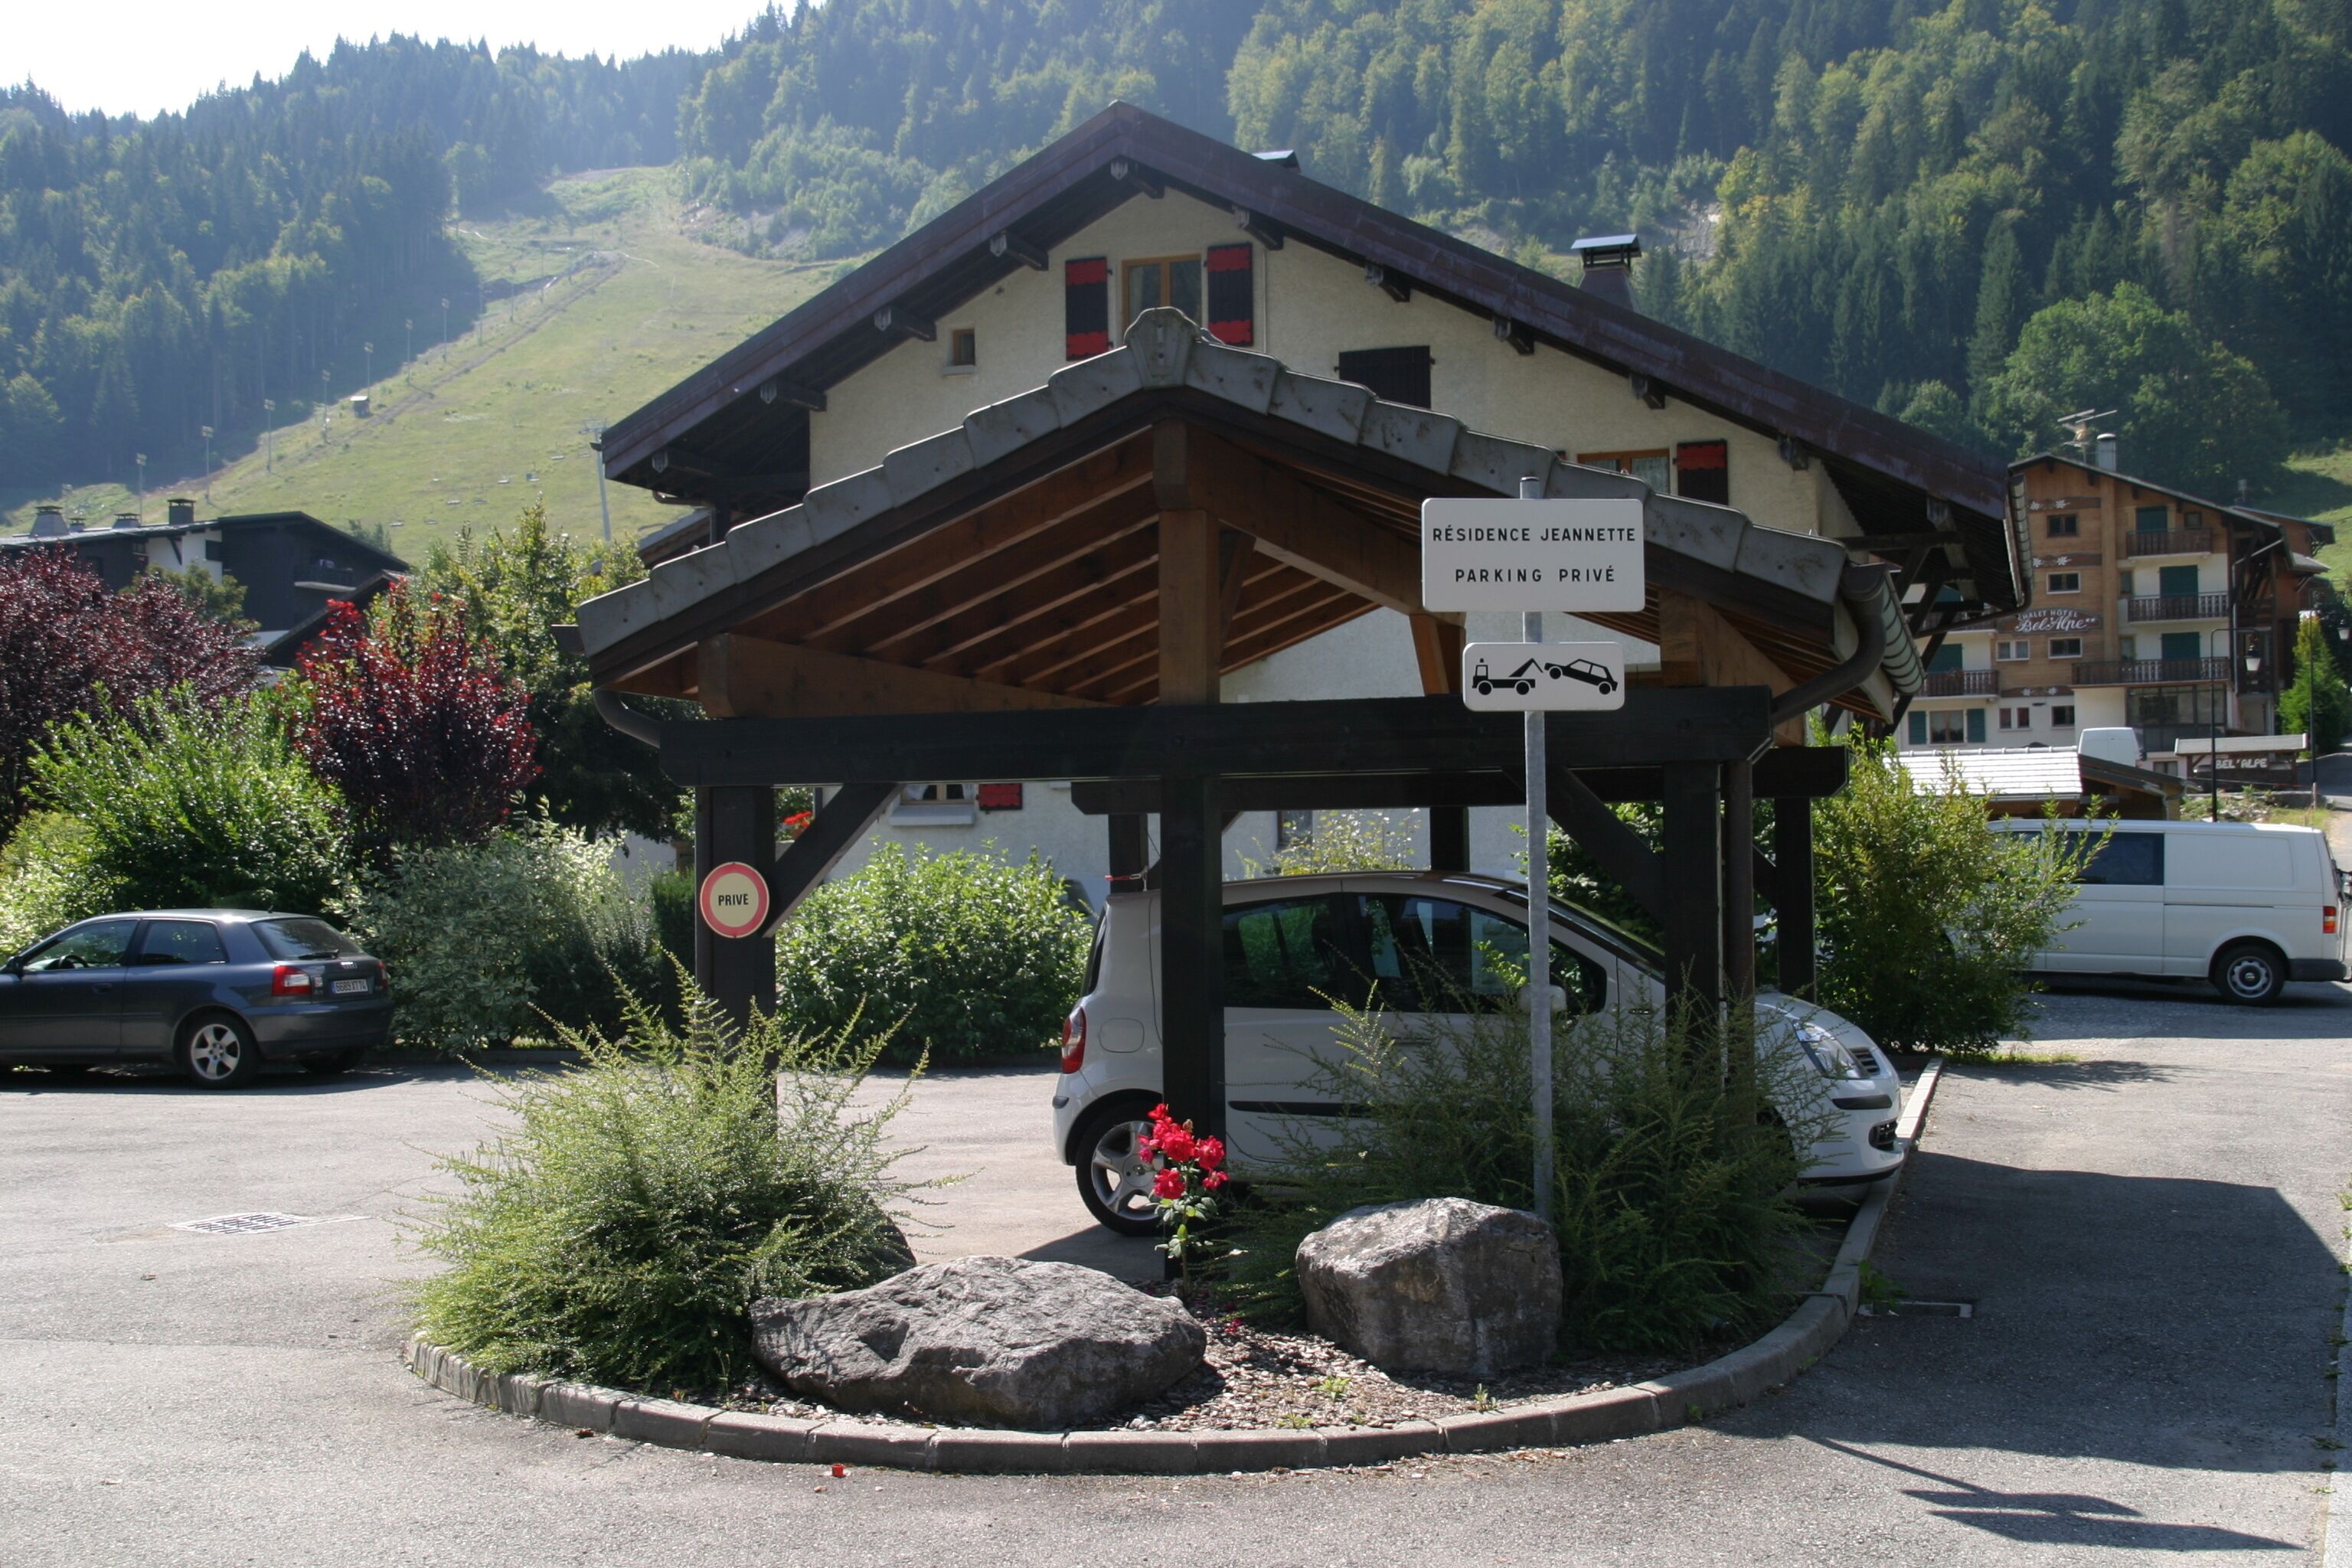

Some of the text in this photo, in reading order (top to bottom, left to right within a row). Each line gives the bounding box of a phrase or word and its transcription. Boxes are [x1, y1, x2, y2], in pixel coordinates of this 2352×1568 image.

[1432, 524, 1635, 541] RÉSIDENCE JEANNETTE
[1455, 565, 1615, 582] PARKING PRIVÉ
[2017, 609, 2047, 621] CHALET
[718, 893, 749, 906] PRIVE
